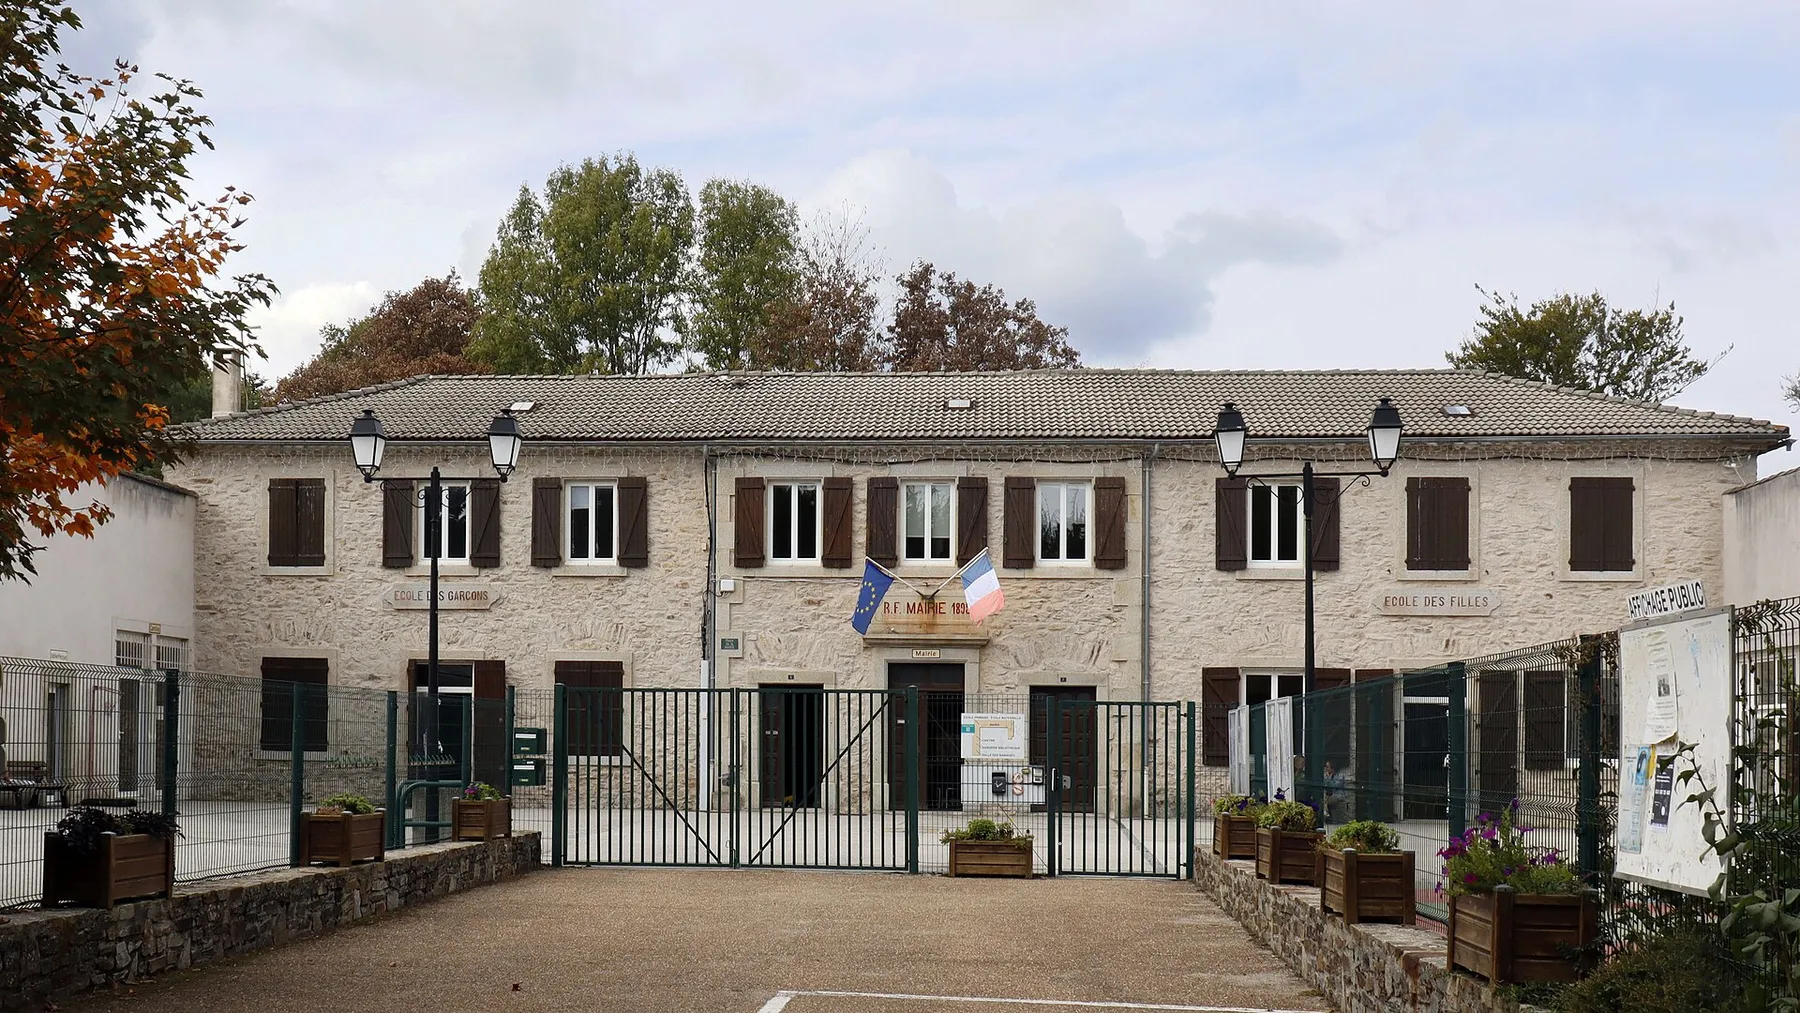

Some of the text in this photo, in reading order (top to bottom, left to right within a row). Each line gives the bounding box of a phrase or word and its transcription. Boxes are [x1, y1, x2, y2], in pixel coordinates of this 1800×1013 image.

[394, 590, 423, 601] ECOLE
[426, 590, 445, 601] DS
[1384, 596, 1489, 608] ECOLE DES FILLES
[1628, 581, 1704, 618] AFFICHAGE PUBLIC
[883, 601, 902, 615] R.F.
[906, 601, 946, 615] MAIRIE
